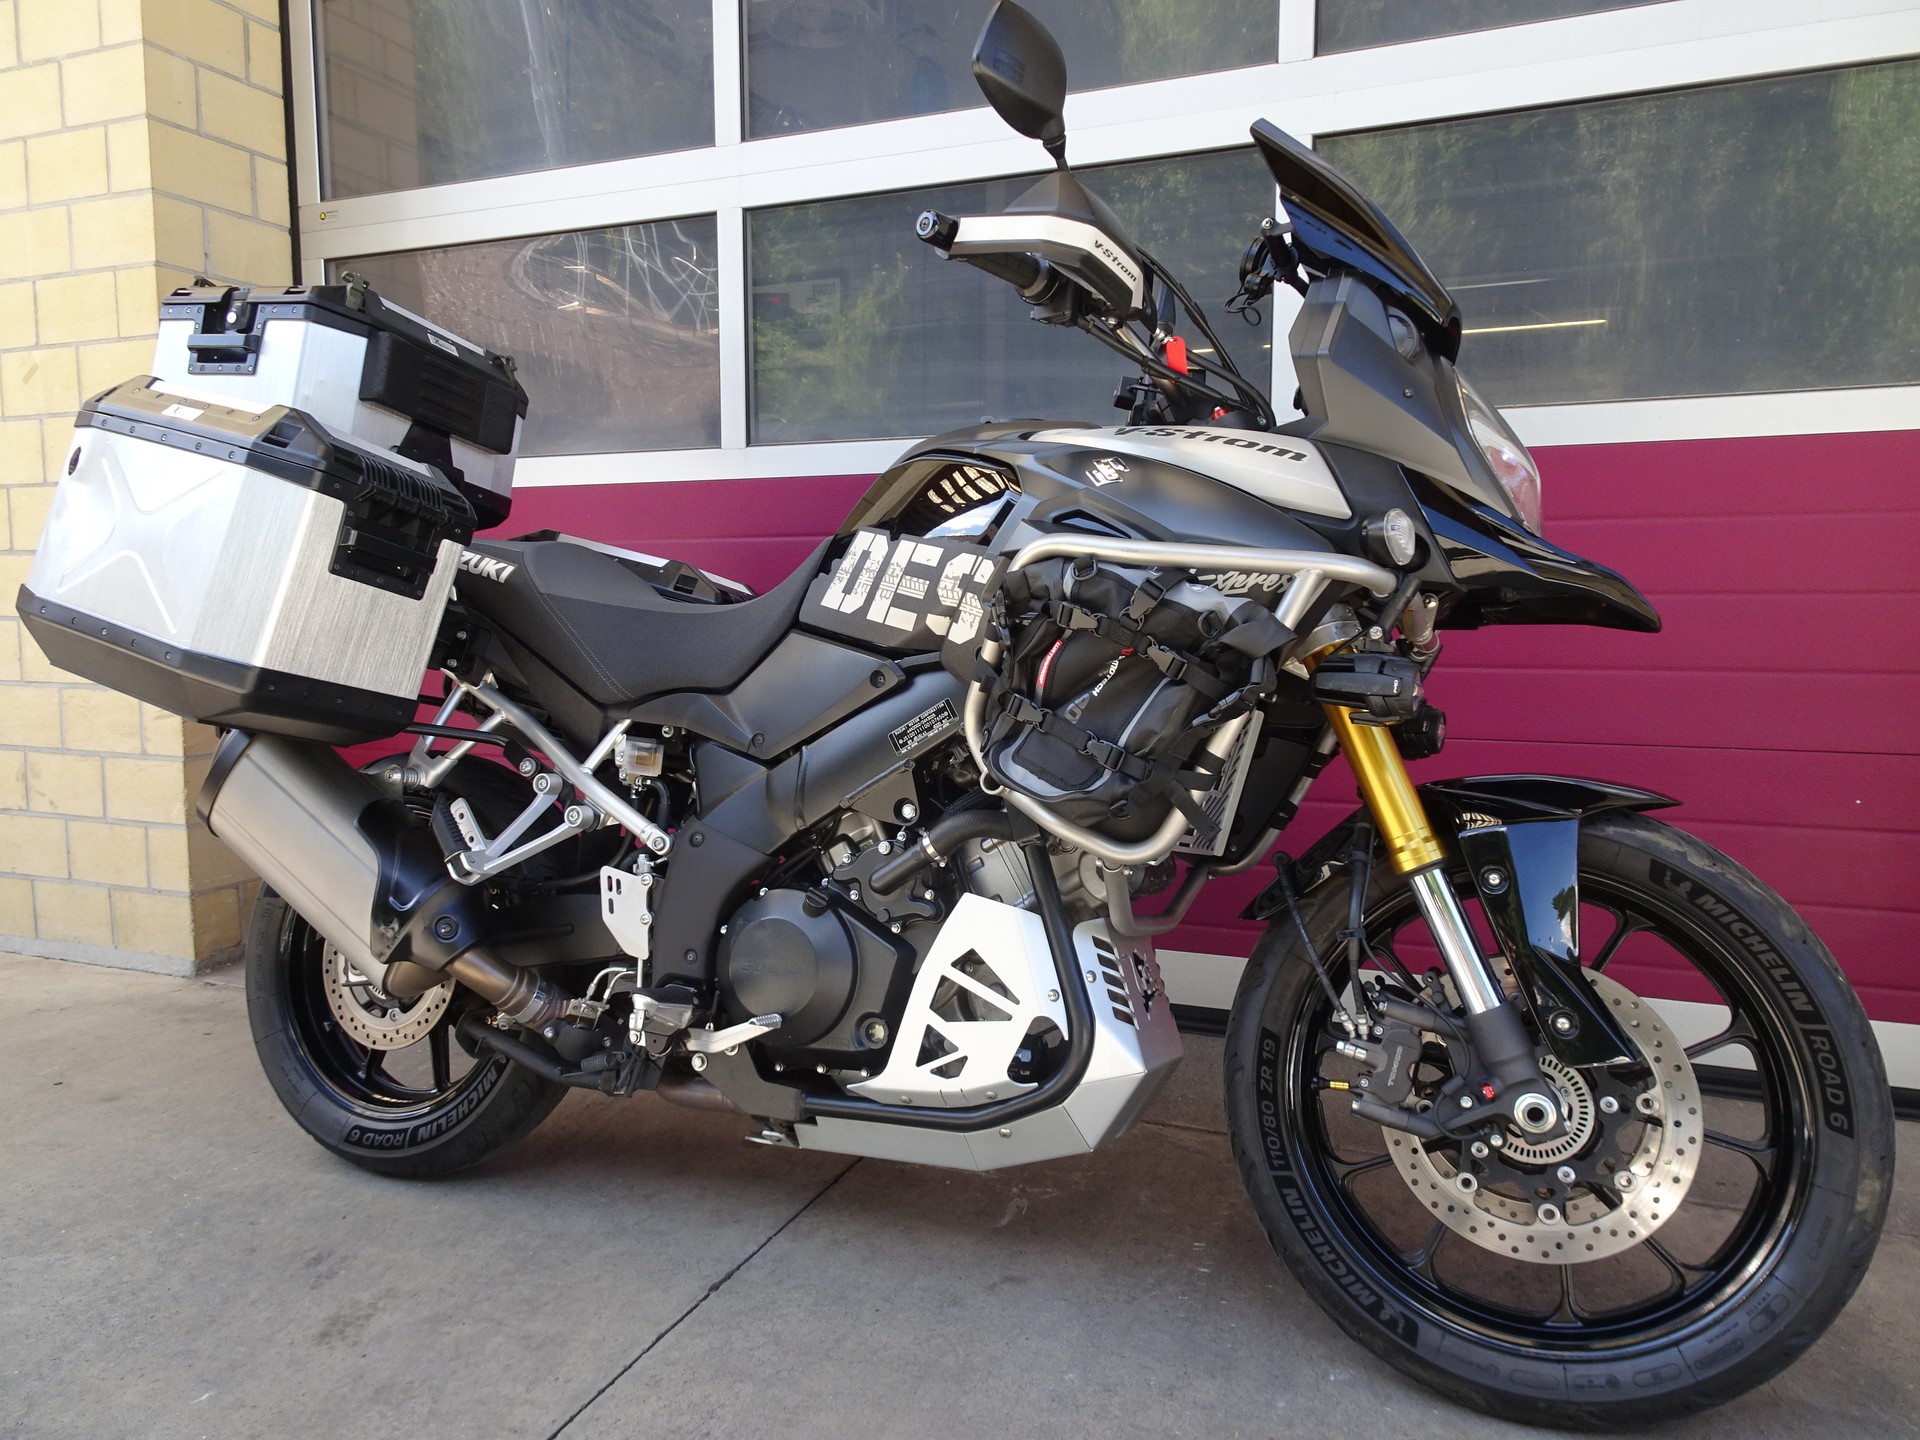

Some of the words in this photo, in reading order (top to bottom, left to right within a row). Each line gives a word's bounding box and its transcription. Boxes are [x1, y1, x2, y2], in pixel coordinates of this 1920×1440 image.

[1094, 239, 1137, 282] V-Strom
[1115, 427, 1308, 462] V-Strom
[1039, 641, 1061, 685] WATERPROOF
[1695, 893, 1814, 1012] MICHELIN
[1809, 1035, 1845, 1106] ROAD
[1830, 1112, 1848, 1131] 6
[1262, 1038, 1276, 1061] 19
[1260, 1066, 1274, 1094] ZR
[416, 1063, 498, 1143] MICHELIN
[350, 1129, 361, 1142] 6
[362, 1131, 406, 1147] ROAD
[1260, 1100, 1285, 1168] 110/80
[1281, 1187, 1378, 1306] MICHELIN
